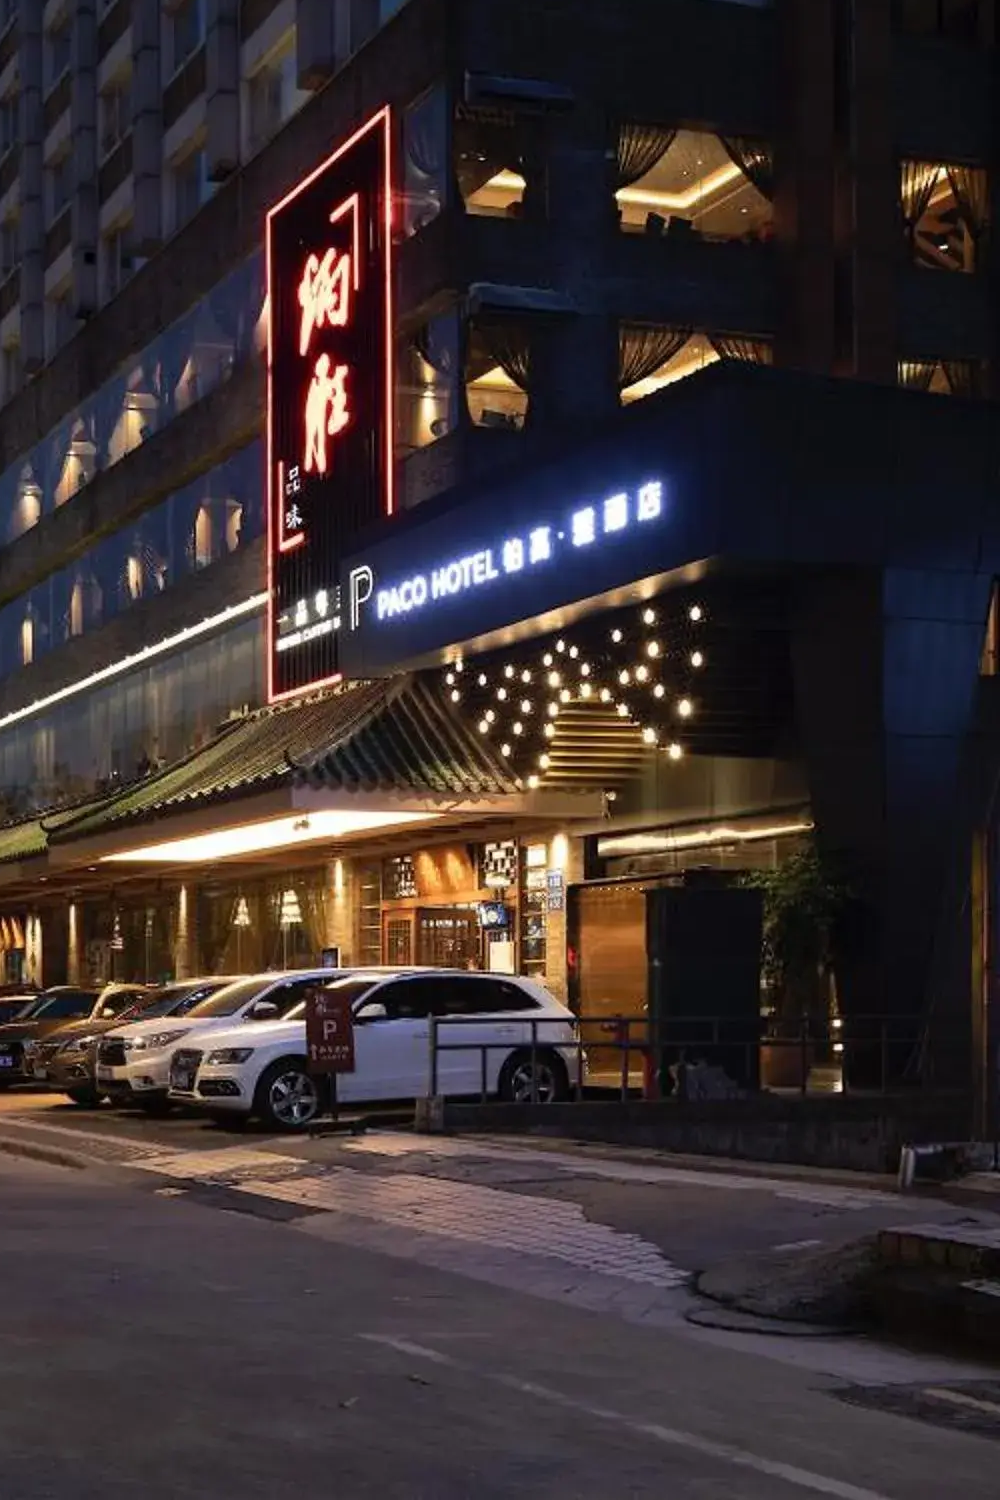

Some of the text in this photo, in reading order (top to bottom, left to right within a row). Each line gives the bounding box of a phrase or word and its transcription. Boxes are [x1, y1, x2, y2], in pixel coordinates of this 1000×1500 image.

[285, 465, 303, 529] 品味
[377, 575, 427, 620] PACO
[431, 549, 499, 599] HOTEL
